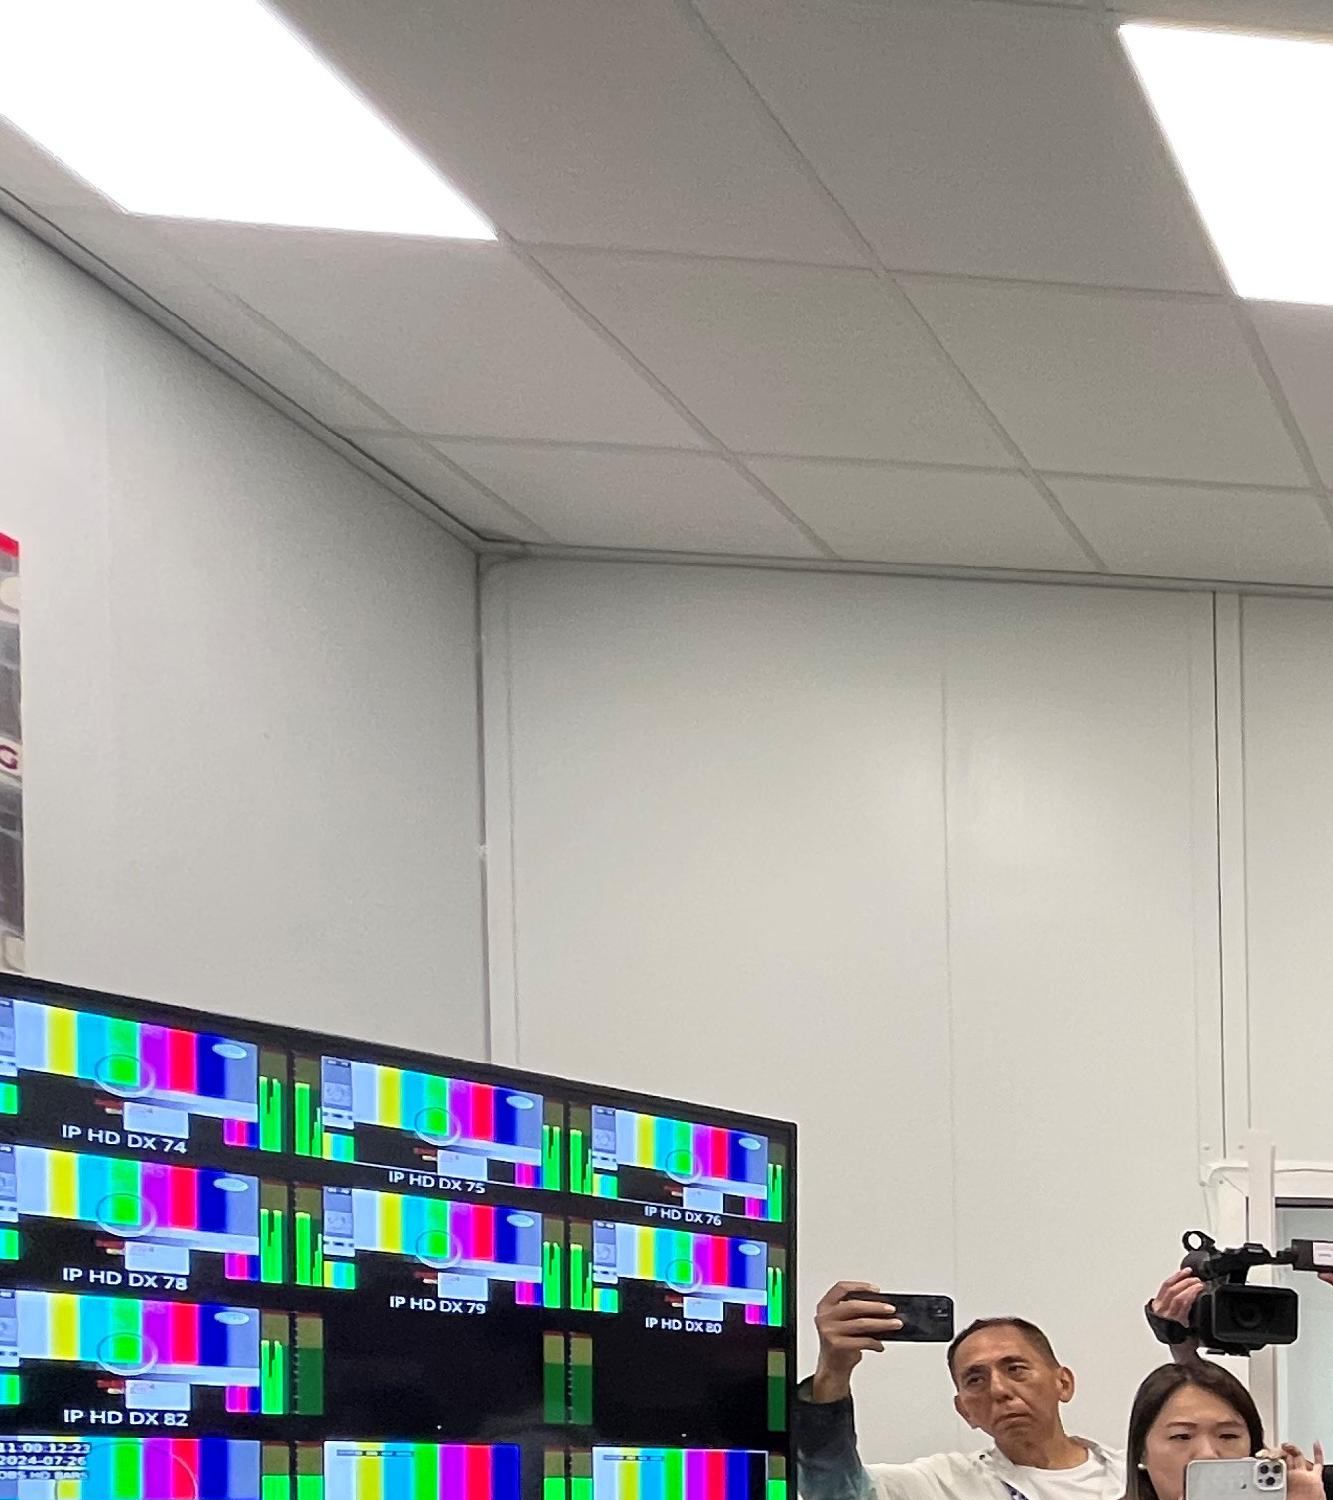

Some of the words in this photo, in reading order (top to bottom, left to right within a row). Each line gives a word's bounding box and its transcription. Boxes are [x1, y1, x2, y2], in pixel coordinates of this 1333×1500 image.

[62, 1124, 81, 1139] IP
[88, 1129, 120, 1145] HD
[127, 1134, 158, 1150] DX
[163, 1139, 187, 1154] 74
[389, 1171, 405, 1183] IP
[409, 1174, 436, 1188] HD
[439, 1177, 463, 1191] DX
[467, 1181, 486, 1194] 75
[645, 1206, 658, 1216] IP
[661, 1208, 682, 1220] HD
[685, 1212, 703, 1224] DX
[705, 1214, 722, 1227] 76
[63, 1267, 82, 1281] IP
[90, 1271, 122, 1285] HD
[129, 1275, 159, 1288] DX
[164, 1277, 188, 1291] 78
[390, 1295, 406, 1308] IP
[410, 1298, 436, 1311] HD
[440, 1301, 463, 1313] DX
[467, 1302, 486, 1315] 79
[645, 1317, 658, 1328] IP
[662, 1319, 682, 1331] HD
[686, 1321, 703, 1333] DX
[64, 1409, 83, 1423] IP
[90, 1411, 122, 1424] HD
[130, 1412, 159, 1425] DX
[163, 1413, 188, 1427] 82
